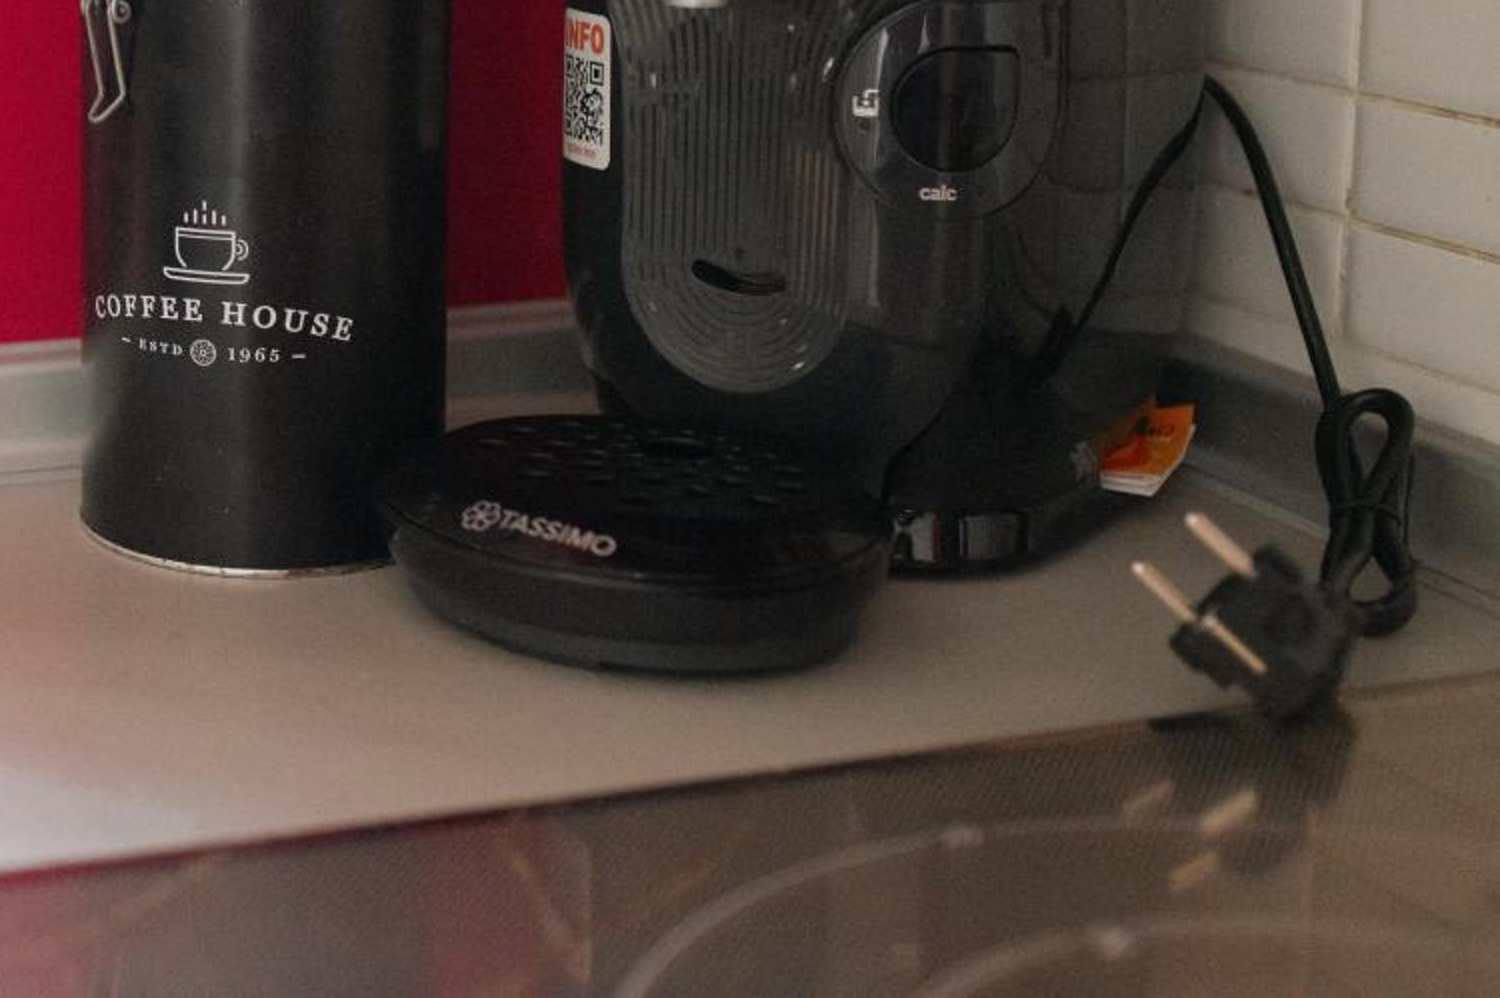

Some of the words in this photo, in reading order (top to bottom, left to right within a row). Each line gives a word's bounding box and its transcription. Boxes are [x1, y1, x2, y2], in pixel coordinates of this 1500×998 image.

[918, 184, 957, 201] calc
[95, 294, 203, 322] COFFEE
[222, 301, 353, 342] HOUSE
[139, 338, 183, 357] ESTD
[227, 346, 280, 363] 1965
[500, 509, 617, 556] TASSIMO
